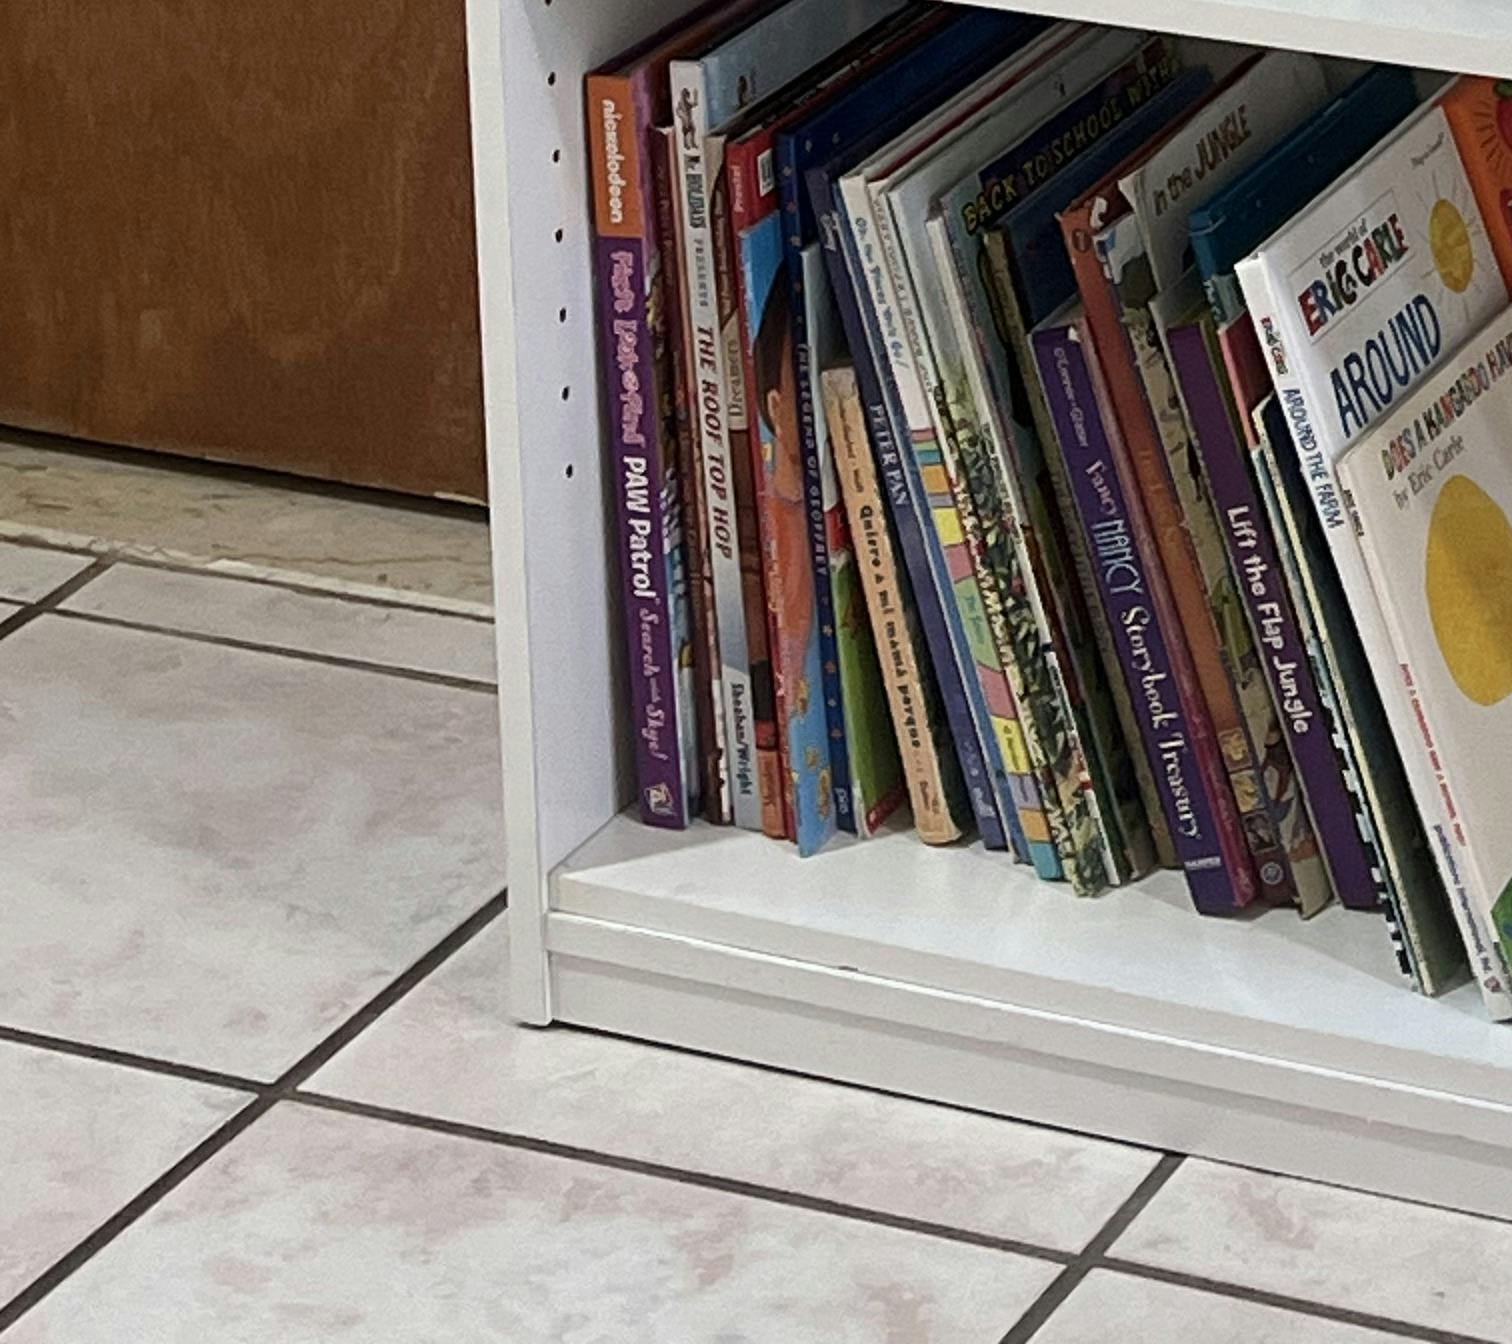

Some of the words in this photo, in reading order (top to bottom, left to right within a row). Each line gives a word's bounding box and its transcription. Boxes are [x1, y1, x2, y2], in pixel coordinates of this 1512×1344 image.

[601, 98, 625, 225] nickelodeon
[960, 173, 1020, 236] BACK
[1022, 153, 1049, 184] TO
[1052, 101, 1124, 165] SCHOOL
[1166, 166, 1193, 199] the
[1194, 104, 1251, 180] JUNGLE
[1298, 271, 1359, 337] ERIC
[1351, 213, 1410, 288] CARLE
[698, 325, 716, 371] THE
[1330, 293, 1442, 438] AROUND
[702, 379, 723, 446] ROOF
[800, 379, 816, 450] LEGEND
[869, 403, 899, 466] PETER
[1280, 386, 1323, 452] AROUND
[1380, 434, 1418, 481] DOES
[1412, 429, 1427, 455] A
[1424, 364, 1491, 443] KANGAROO
[621, 456, 648, 513] PAW
[706, 453, 726, 499] TOP
[805, 455, 819, 478] OF
[879, 467, 910, 508] PAN
[1083, 458, 1119, 517] Fancy
[1301, 452, 1329, 486] THE
[1407, 458, 1434, 495] Eric
[1431, 434, 1465, 475] Carle
[712, 507, 734, 561] HOP
[858, 504, 885, 569] Quiero
[1311, 486, 1345, 530] FARM
[627, 517, 658, 598] Patrol
[1090, 517, 1146, 597] NANCY
[638, 607, 661, 678] Search
[1224, 504, 1255, 550] Lift
[1240, 552, 1270, 599] the
[1255, 600, 1289, 652] Flap
[1272, 655, 1313, 735] Jungle
[1117, 605, 1171, 731] Storybook
[1158, 729, 1205, 842] Treasury
